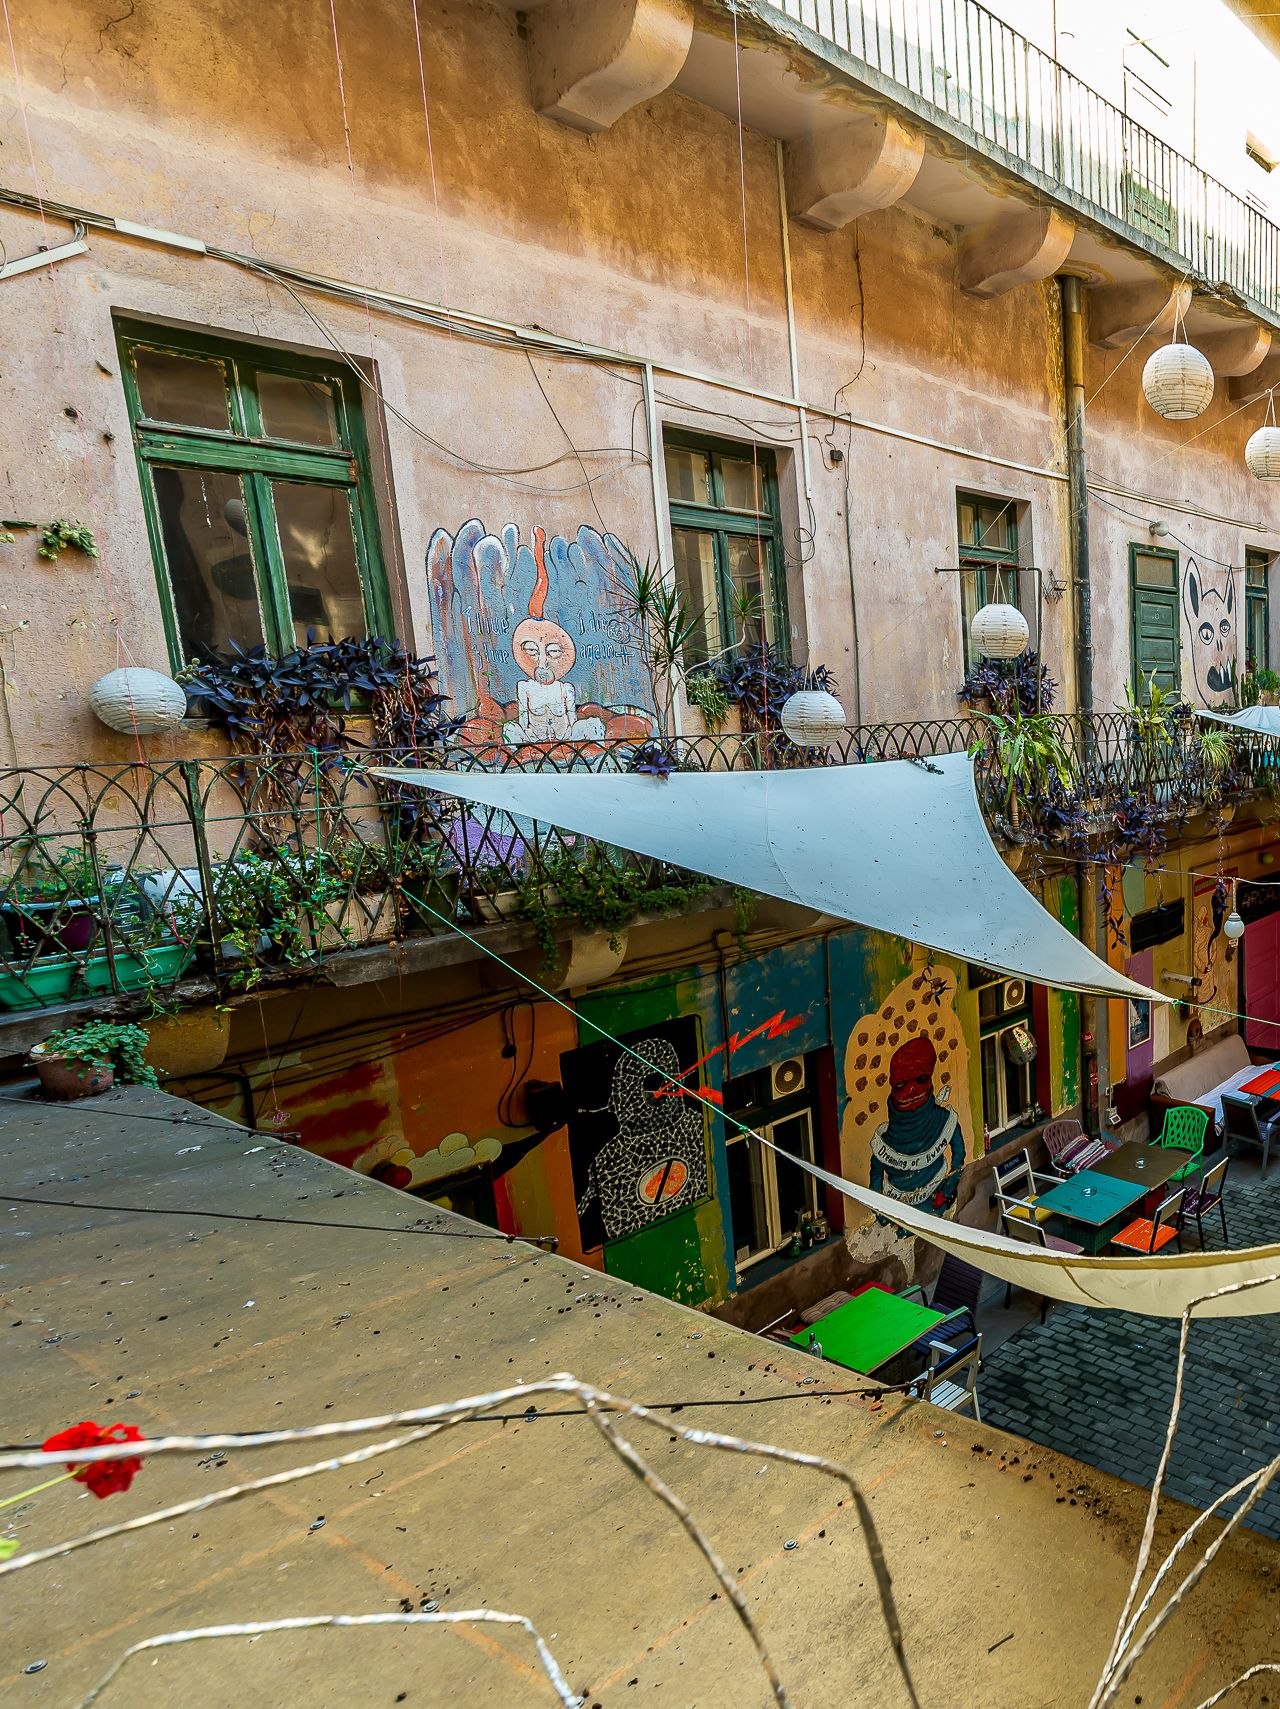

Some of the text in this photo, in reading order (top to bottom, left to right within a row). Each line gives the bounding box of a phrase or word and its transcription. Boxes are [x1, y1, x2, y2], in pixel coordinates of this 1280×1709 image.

[878, 1138, 947, 1168] Dreaming of living
